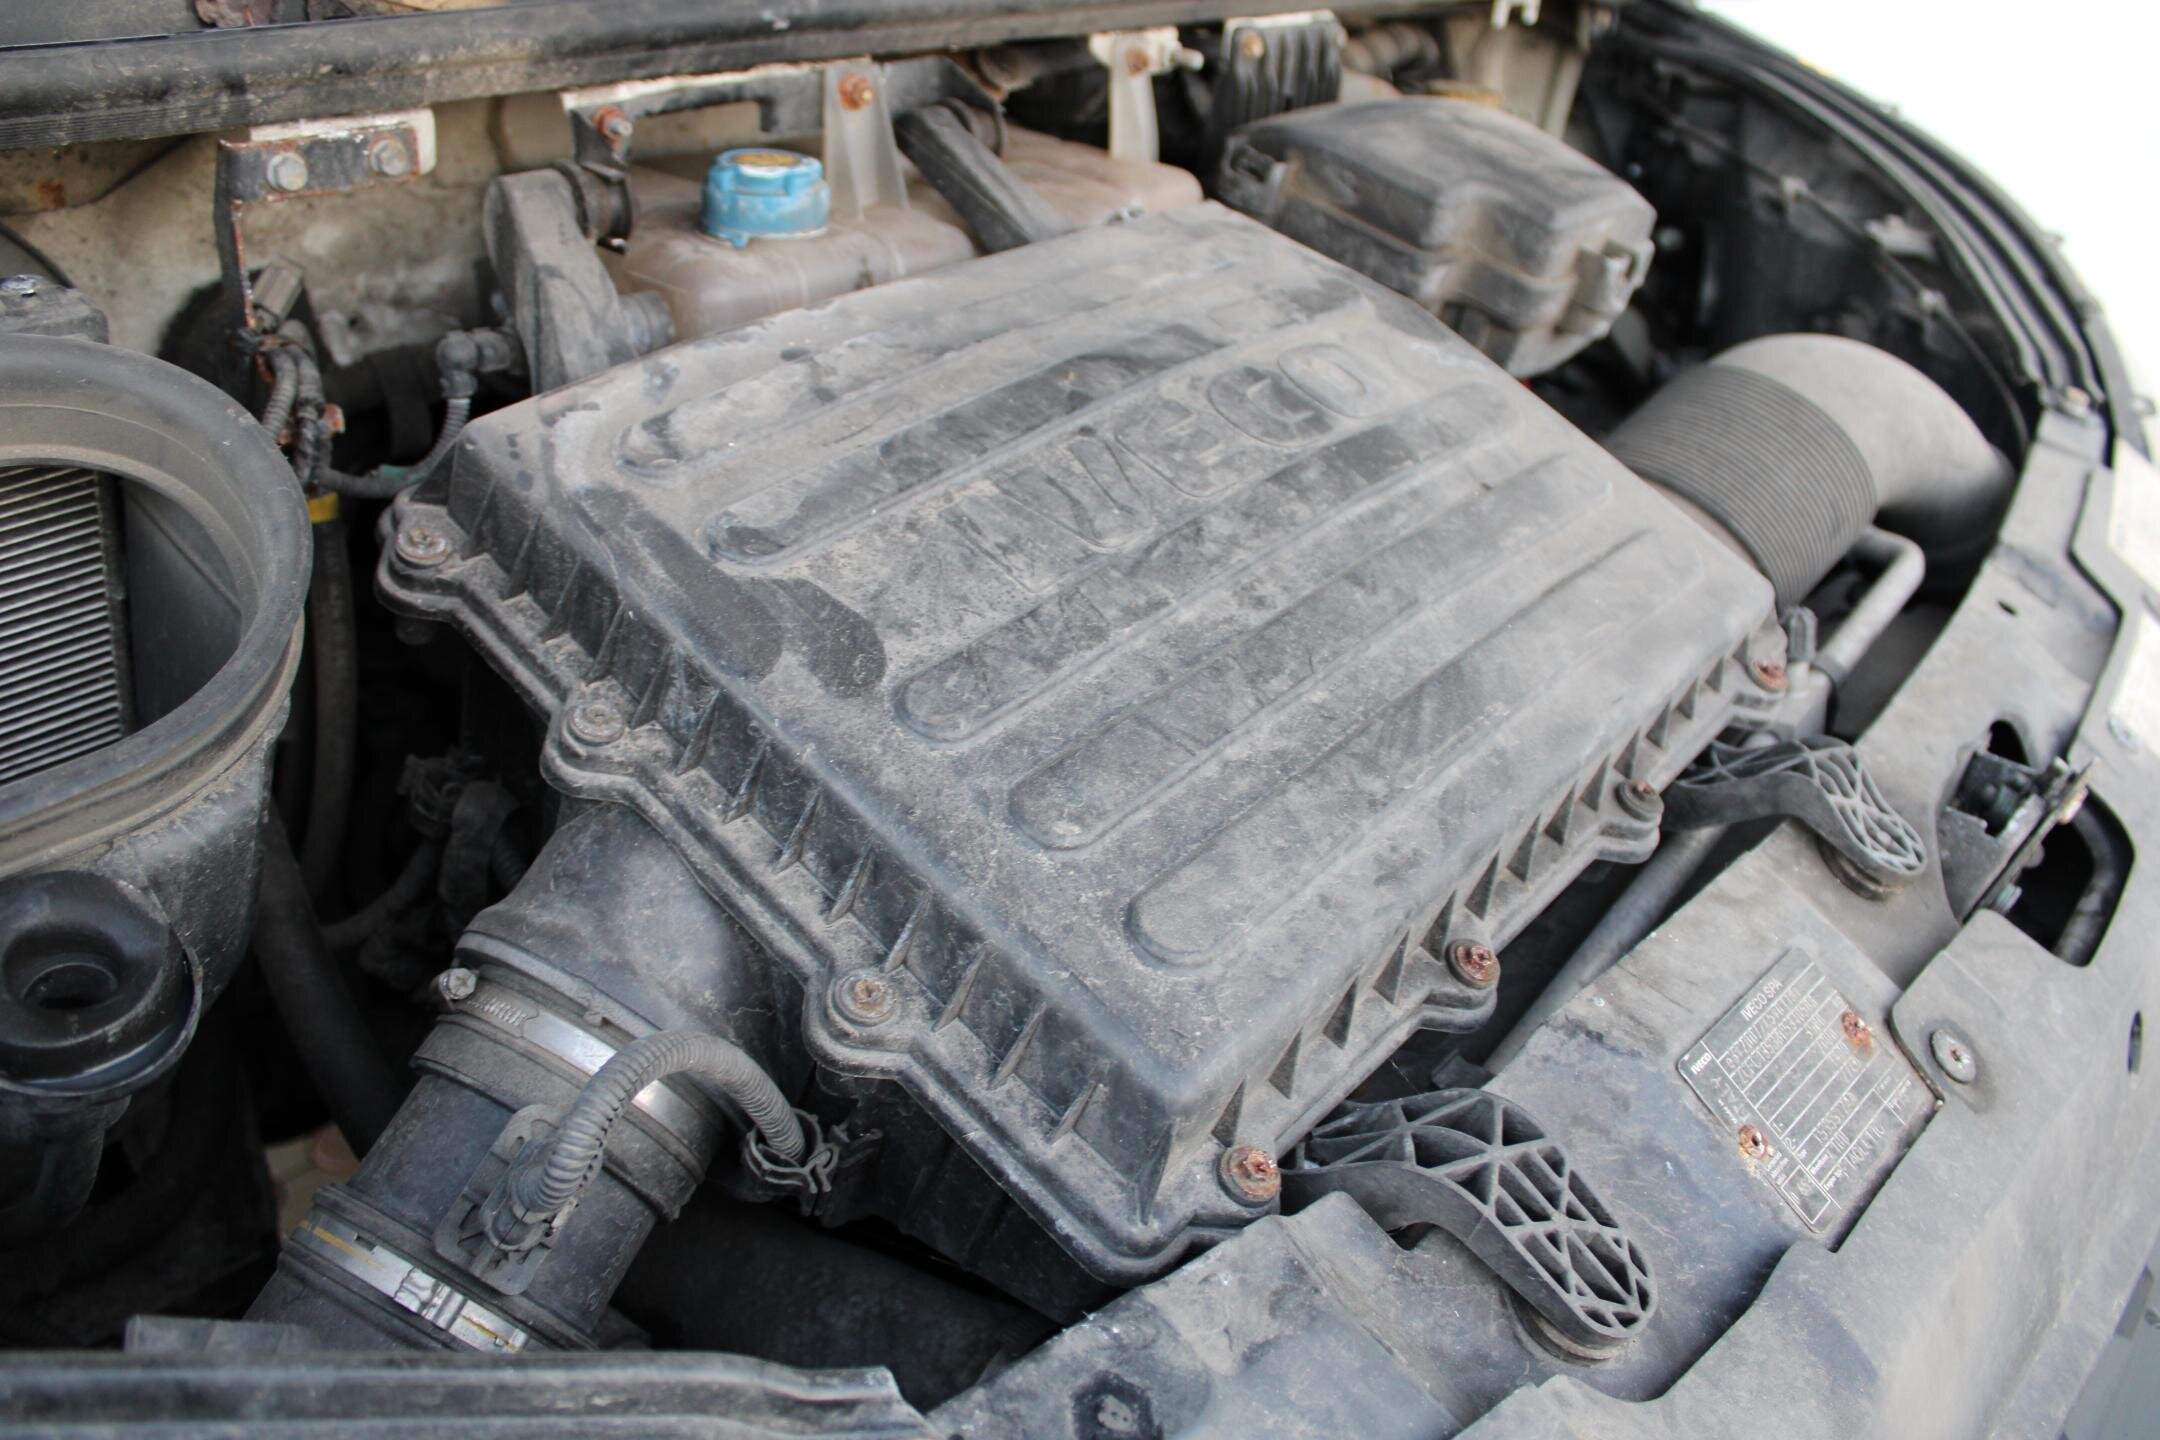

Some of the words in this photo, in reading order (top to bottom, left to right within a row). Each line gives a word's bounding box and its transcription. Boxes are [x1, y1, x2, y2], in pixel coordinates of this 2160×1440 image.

[940, 342, 1390, 594] IVECO
[1740, 991, 1769, 1022] IVECO
[1762, 977, 1783, 999] SPA
[1690, 1051, 1712, 1075] IVECO
